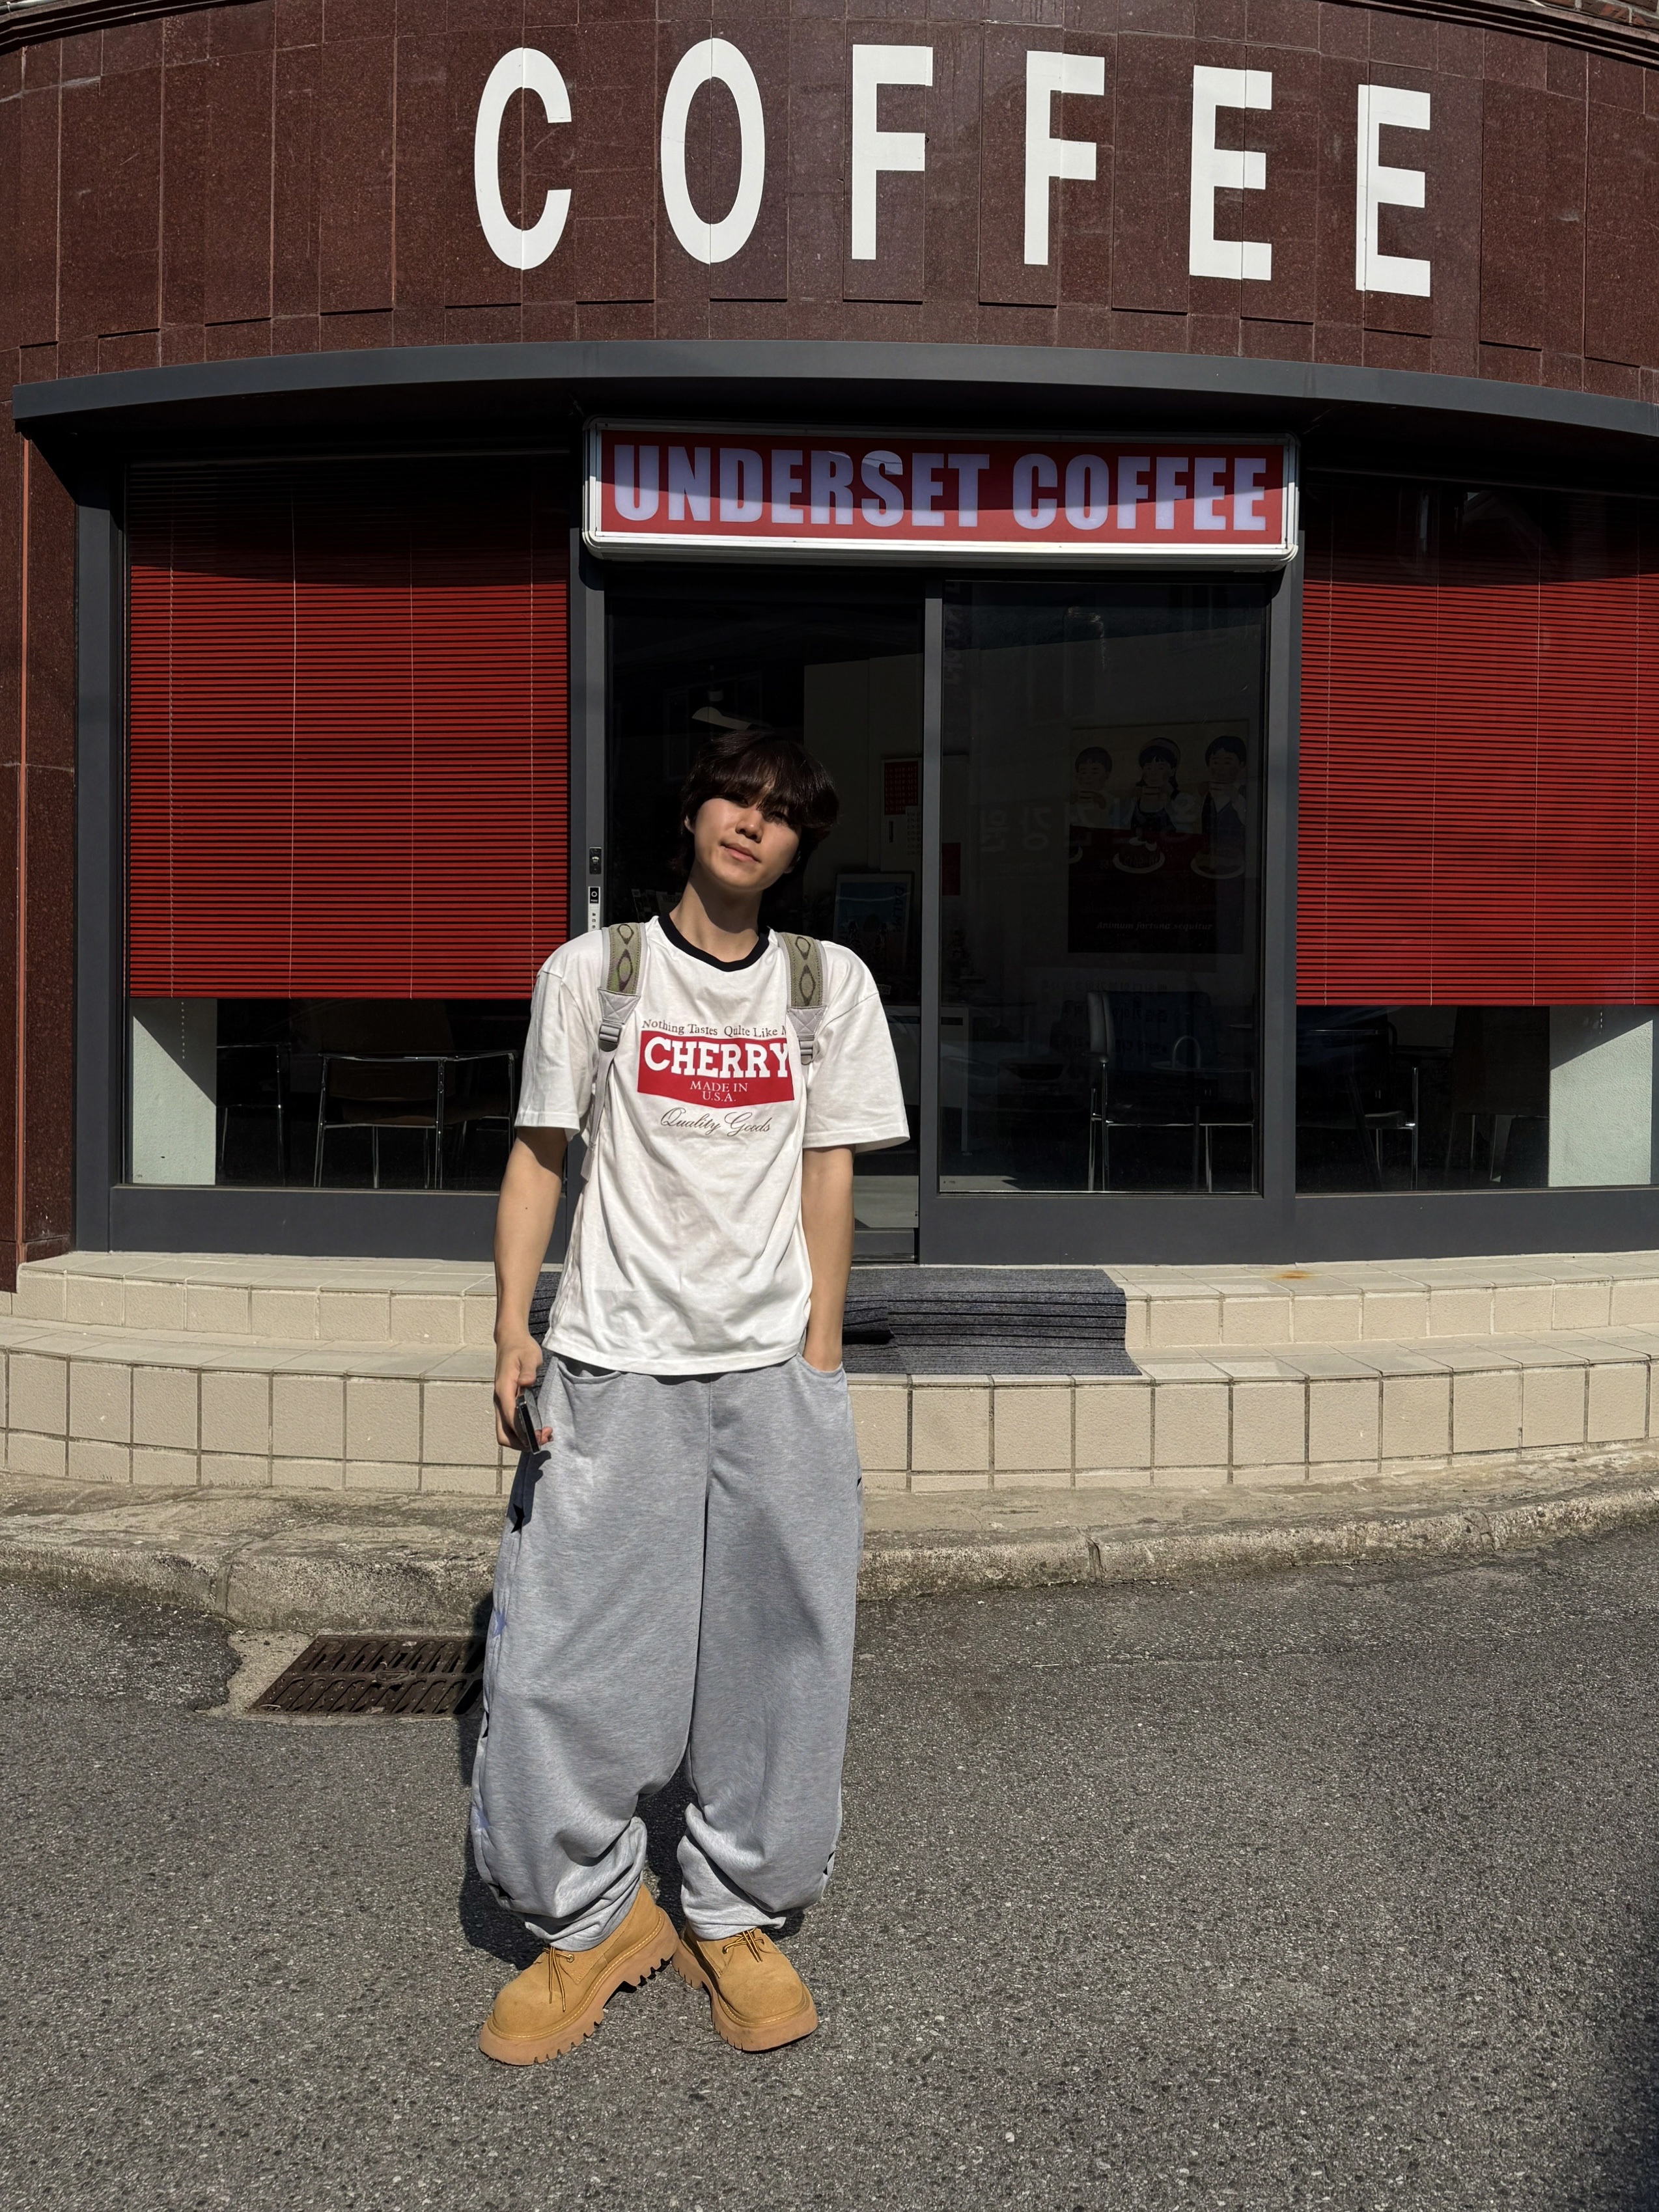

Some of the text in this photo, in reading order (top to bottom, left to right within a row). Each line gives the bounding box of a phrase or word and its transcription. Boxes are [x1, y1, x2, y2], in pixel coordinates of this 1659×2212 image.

[474, 37, 1431, 297] COFFEE
[614, 444, 1266, 531] UNDERSET COFFEE
[1096, 921, 1213, 932] Animum fortuna sequitur
[642, 1019, 685, 1036] Nothing
[687, 1023, 718, 1036] Tastes
[753, 1027, 778, 1038] Like
[644, 1036, 789, 1079] CHERRY
[690, 1081, 748, 1092] MADE IN
[702, 1090, 736, 1102] U.S.A.
[660, 1107, 773, 1137] Quality Goods
